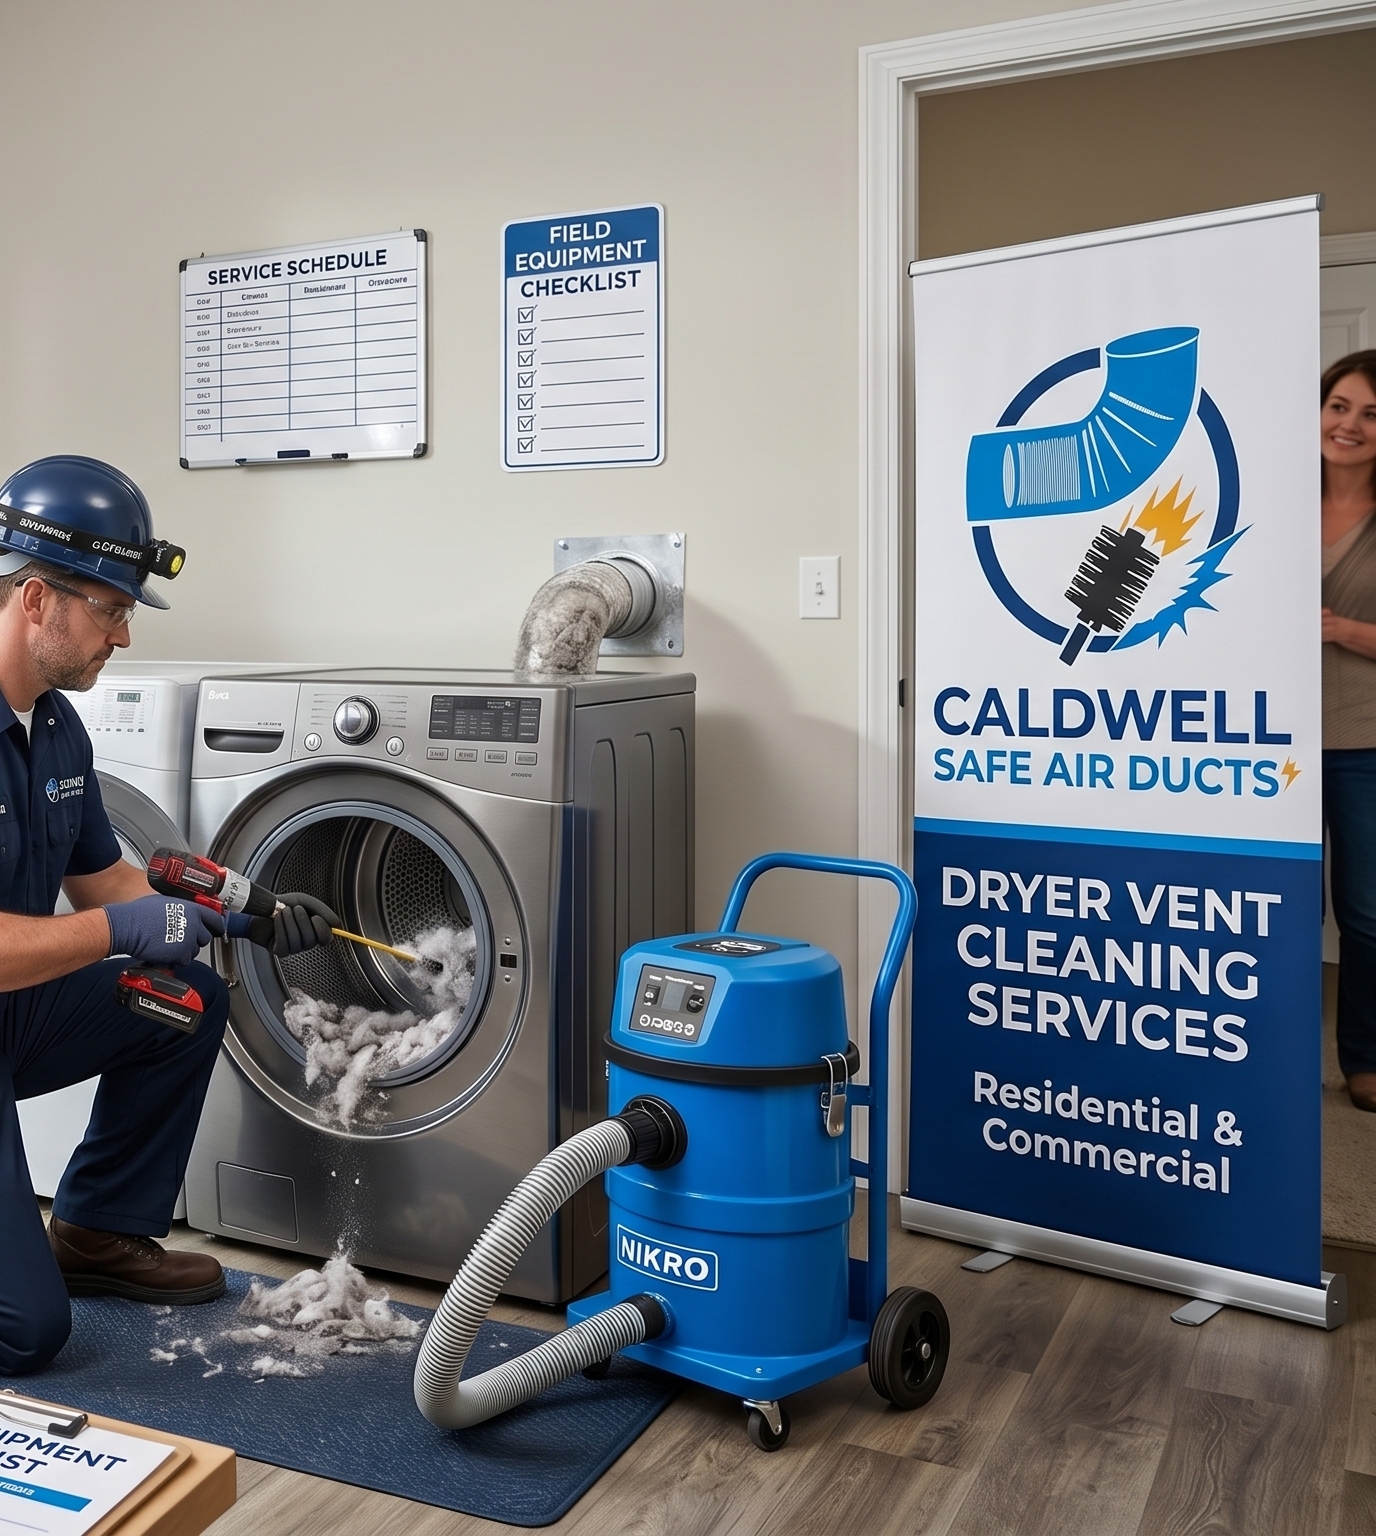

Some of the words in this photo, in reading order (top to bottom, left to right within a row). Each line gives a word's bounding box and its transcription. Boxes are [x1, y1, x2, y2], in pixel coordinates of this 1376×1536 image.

[515, 239, 647, 271] EQUIPMENT
[549, 220, 611, 244] FIELD
[208, 262, 282, 286] SERVICE
[287, 249, 387, 276] SCHEDULE
[520, 269, 641, 298] CHECKLIST
[933, 686, 1292, 744] CALDWELL
[933, 748, 1032, 785] SAFE
[1043, 752, 1115, 790] AIR
[1128, 756, 1280, 798] DUCTS
[942, 866, 1112, 922] DRYER
[1126, 881, 1282, 937] VENT
[956, 923, 1259, 1000] CLEANING
[967, 982, 1249, 1062] SERVICES
[973, 1070, 1199, 1140] Residential
[1213, 1110, 1244, 1147] &
[982, 1117, 1230, 1194] Commercial
[621, 1235, 709, 1282] NIKRO
